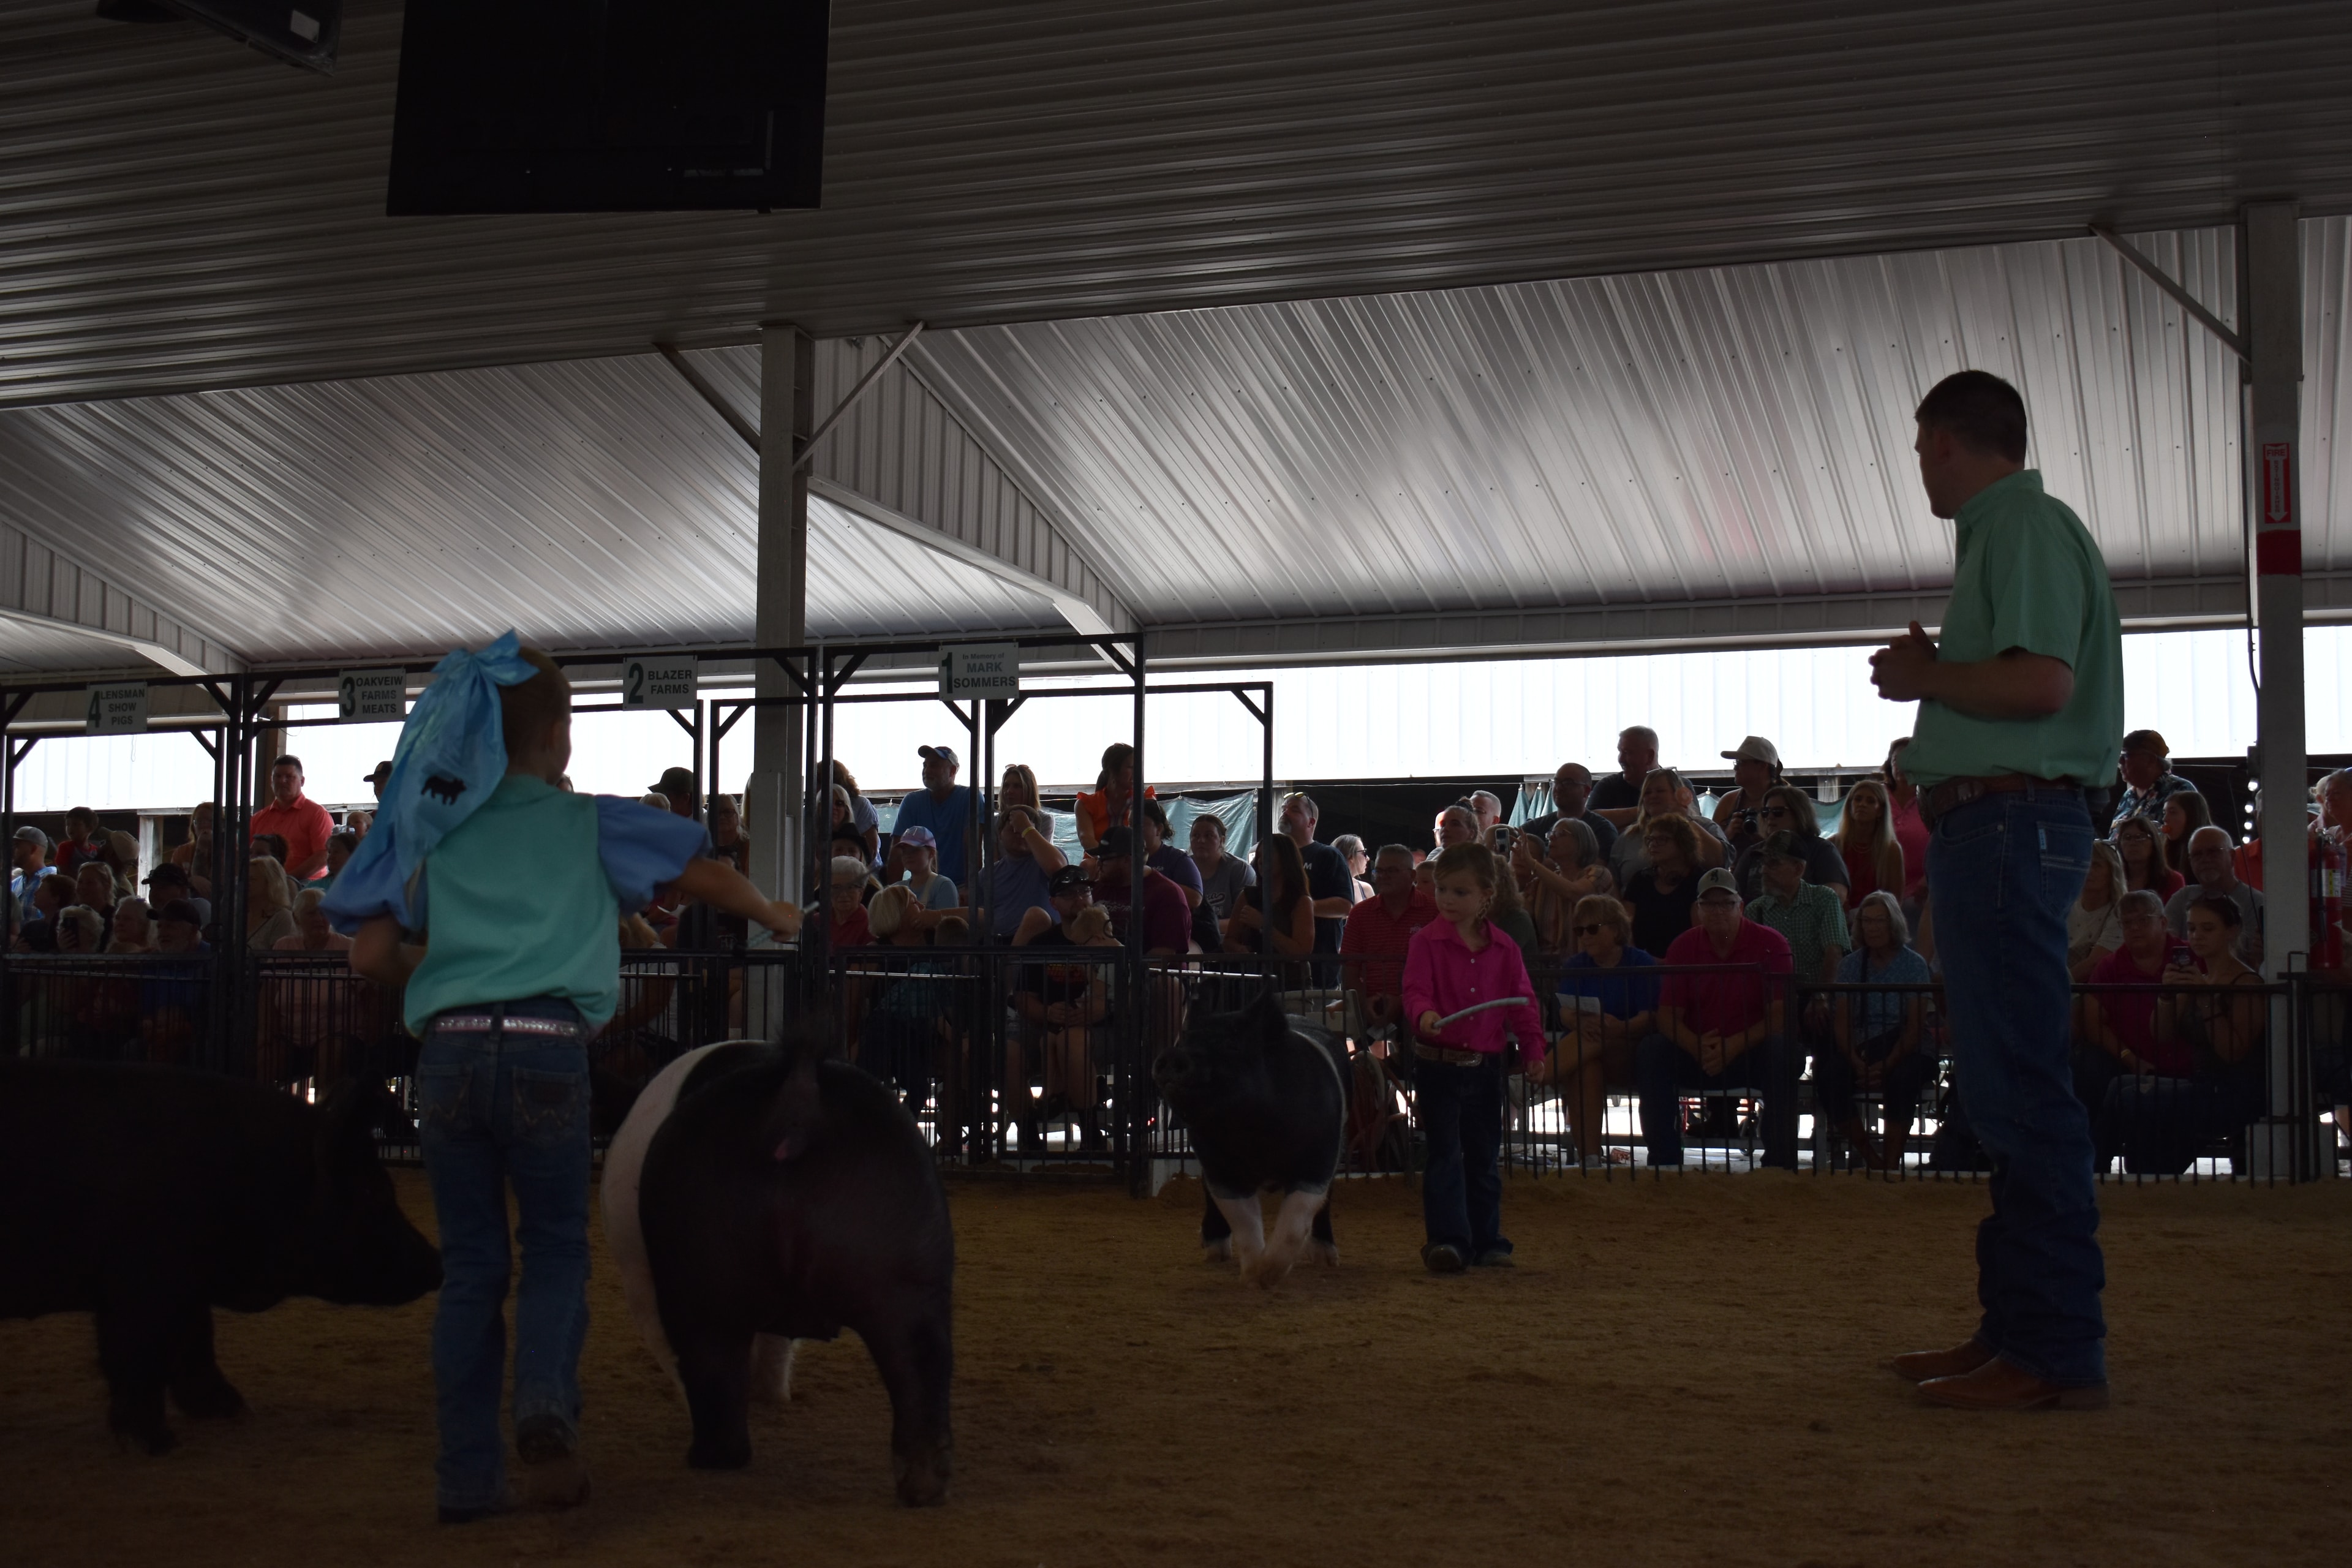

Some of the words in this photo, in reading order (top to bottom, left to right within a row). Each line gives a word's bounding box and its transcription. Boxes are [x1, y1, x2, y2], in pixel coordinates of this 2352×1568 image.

[941, 652, 953, 693] 1
[967, 662, 1003, 673] MARK
[648, 669, 692, 680] BLAZER
[356, 676, 403, 687] OAKVEIW
[628, 663, 644, 704] 2
[954, 676, 1016, 688] SOMMERS
[100, 688, 145, 699] LENSMAN
[651, 684, 689, 694] FARMS
[342, 677, 356, 717] 3
[362, 690, 396, 700] FARMS
[88, 691, 101, 728] 4
[108, 703, 137, 712] SHOW
[363, 704, 396, 714] MEATS
[111, 715, 133, 725] PIGS
